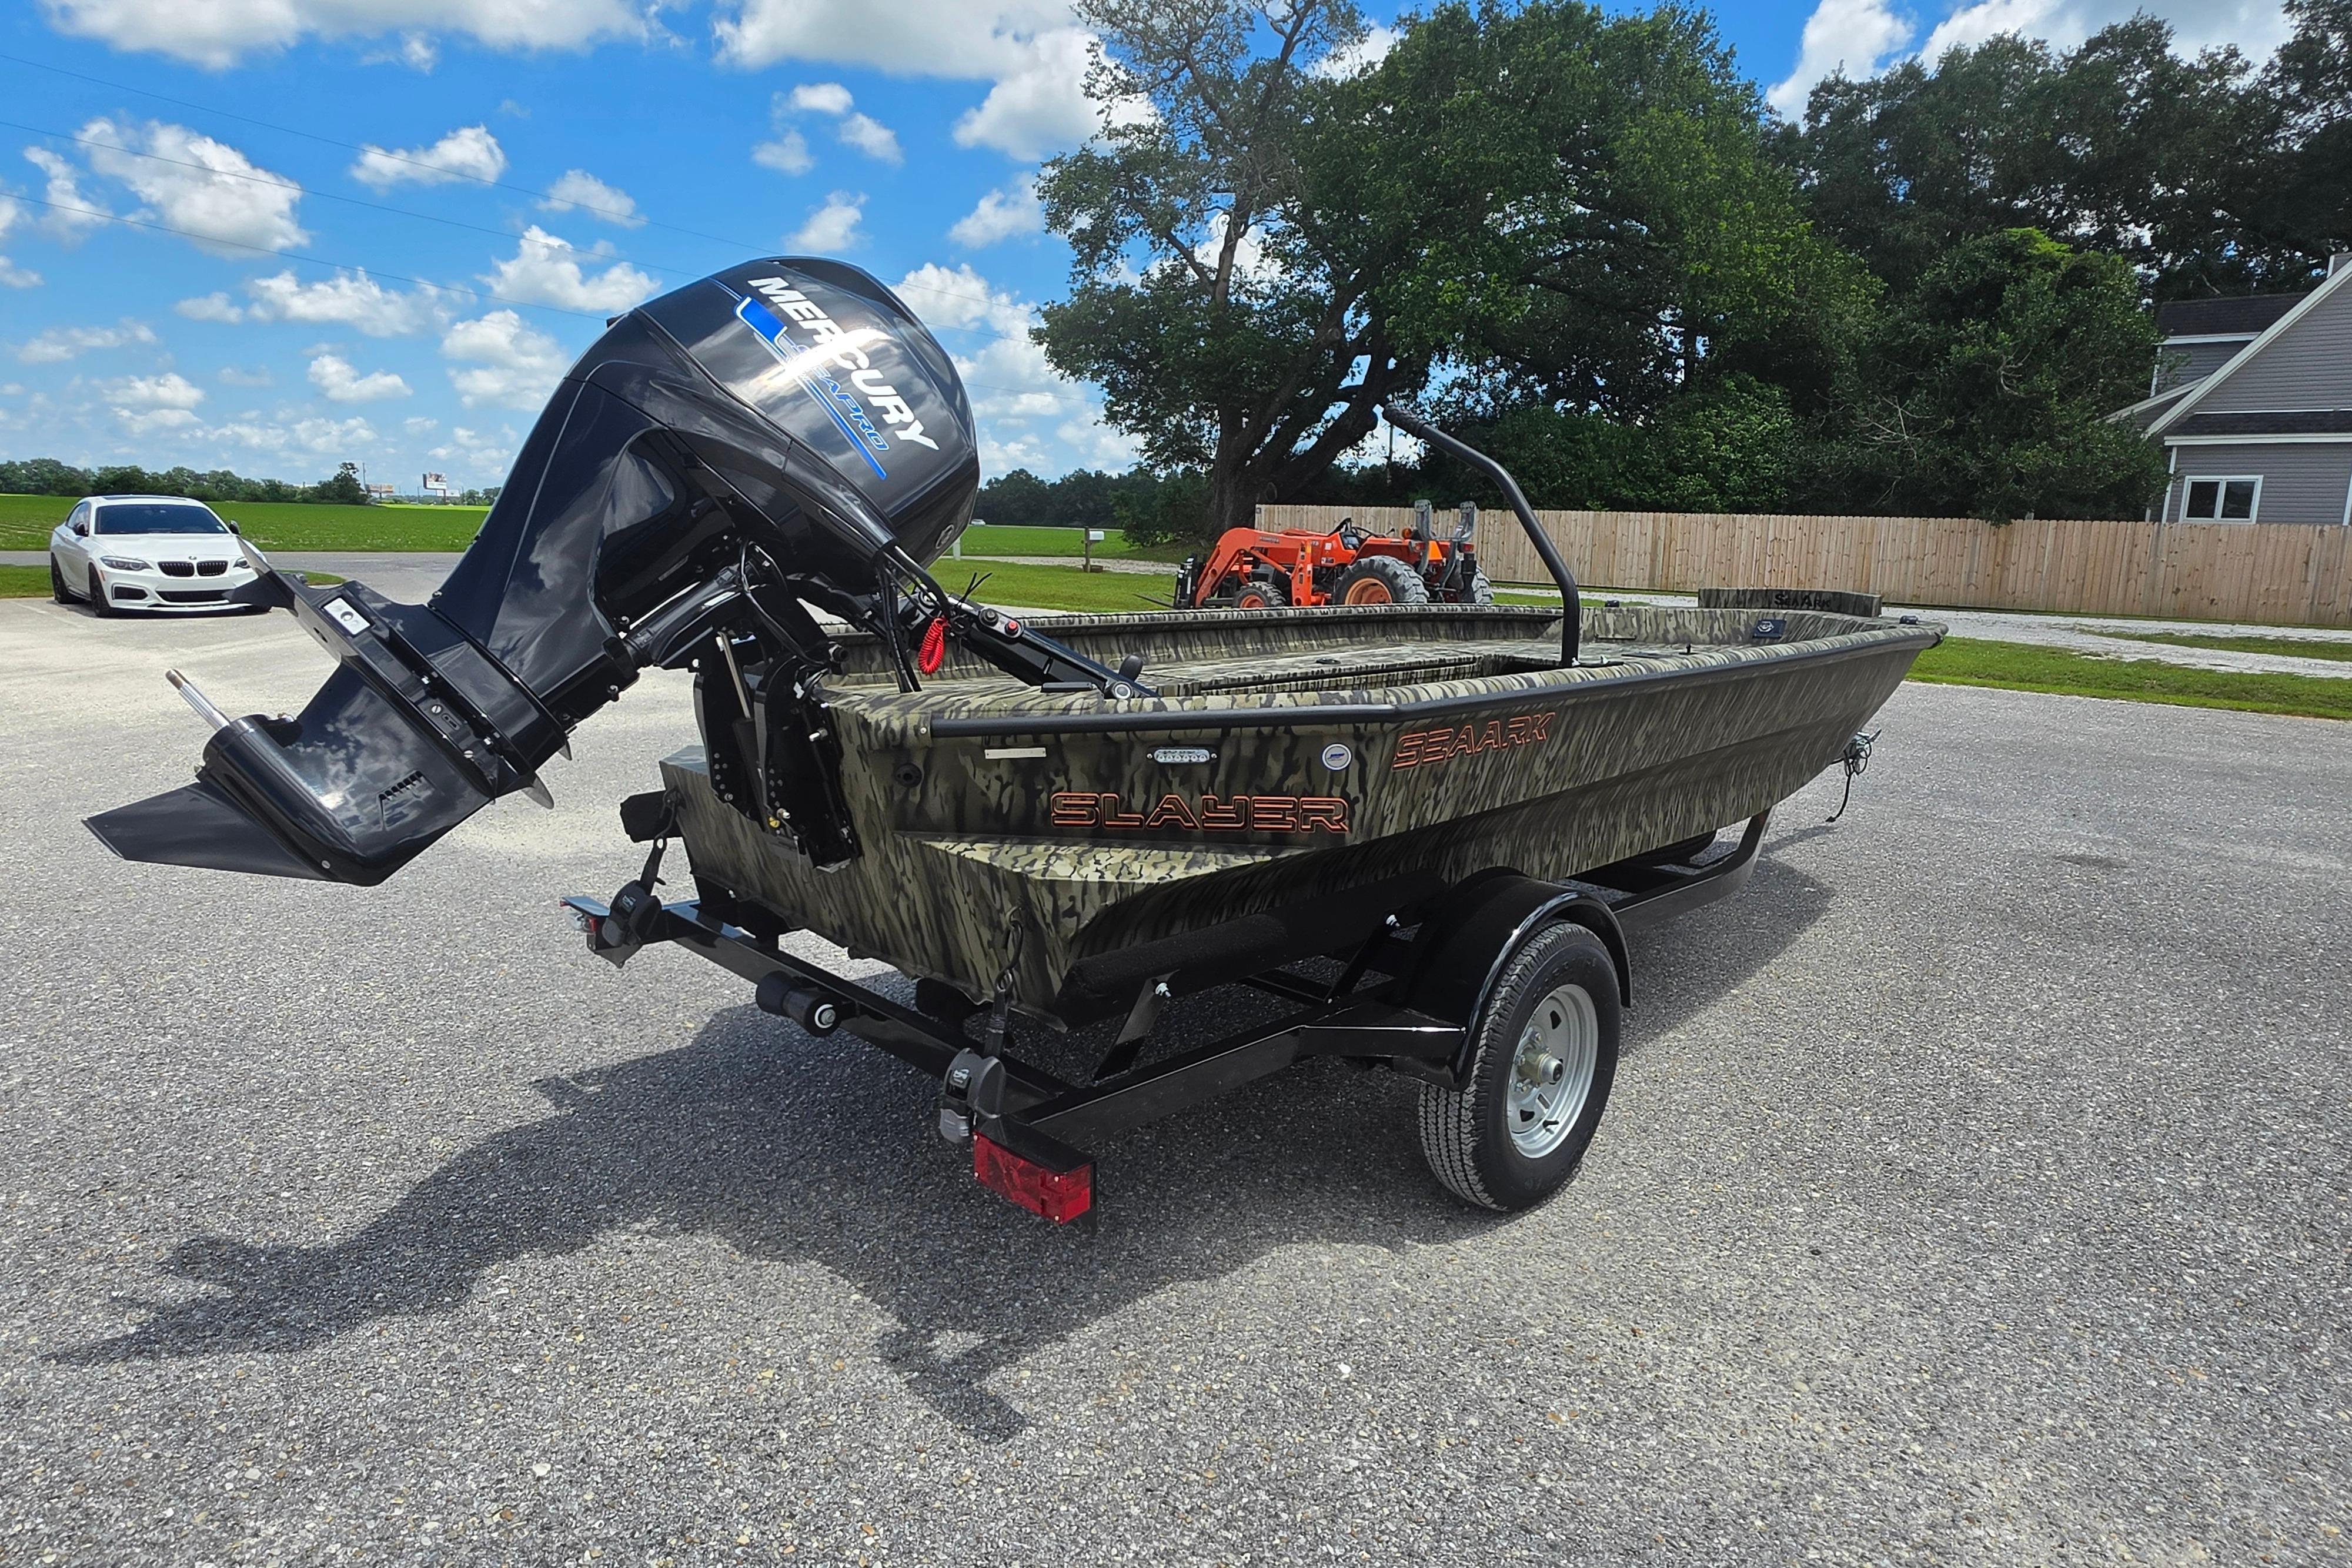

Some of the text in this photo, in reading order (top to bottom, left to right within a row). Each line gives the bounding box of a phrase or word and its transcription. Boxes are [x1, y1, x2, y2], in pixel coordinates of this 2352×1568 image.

[748, 277, 940, 451] MERCURY
[1392, 711, 1556, 773] SEAARK
[1051, 792, 1349, 834] SLAYER
